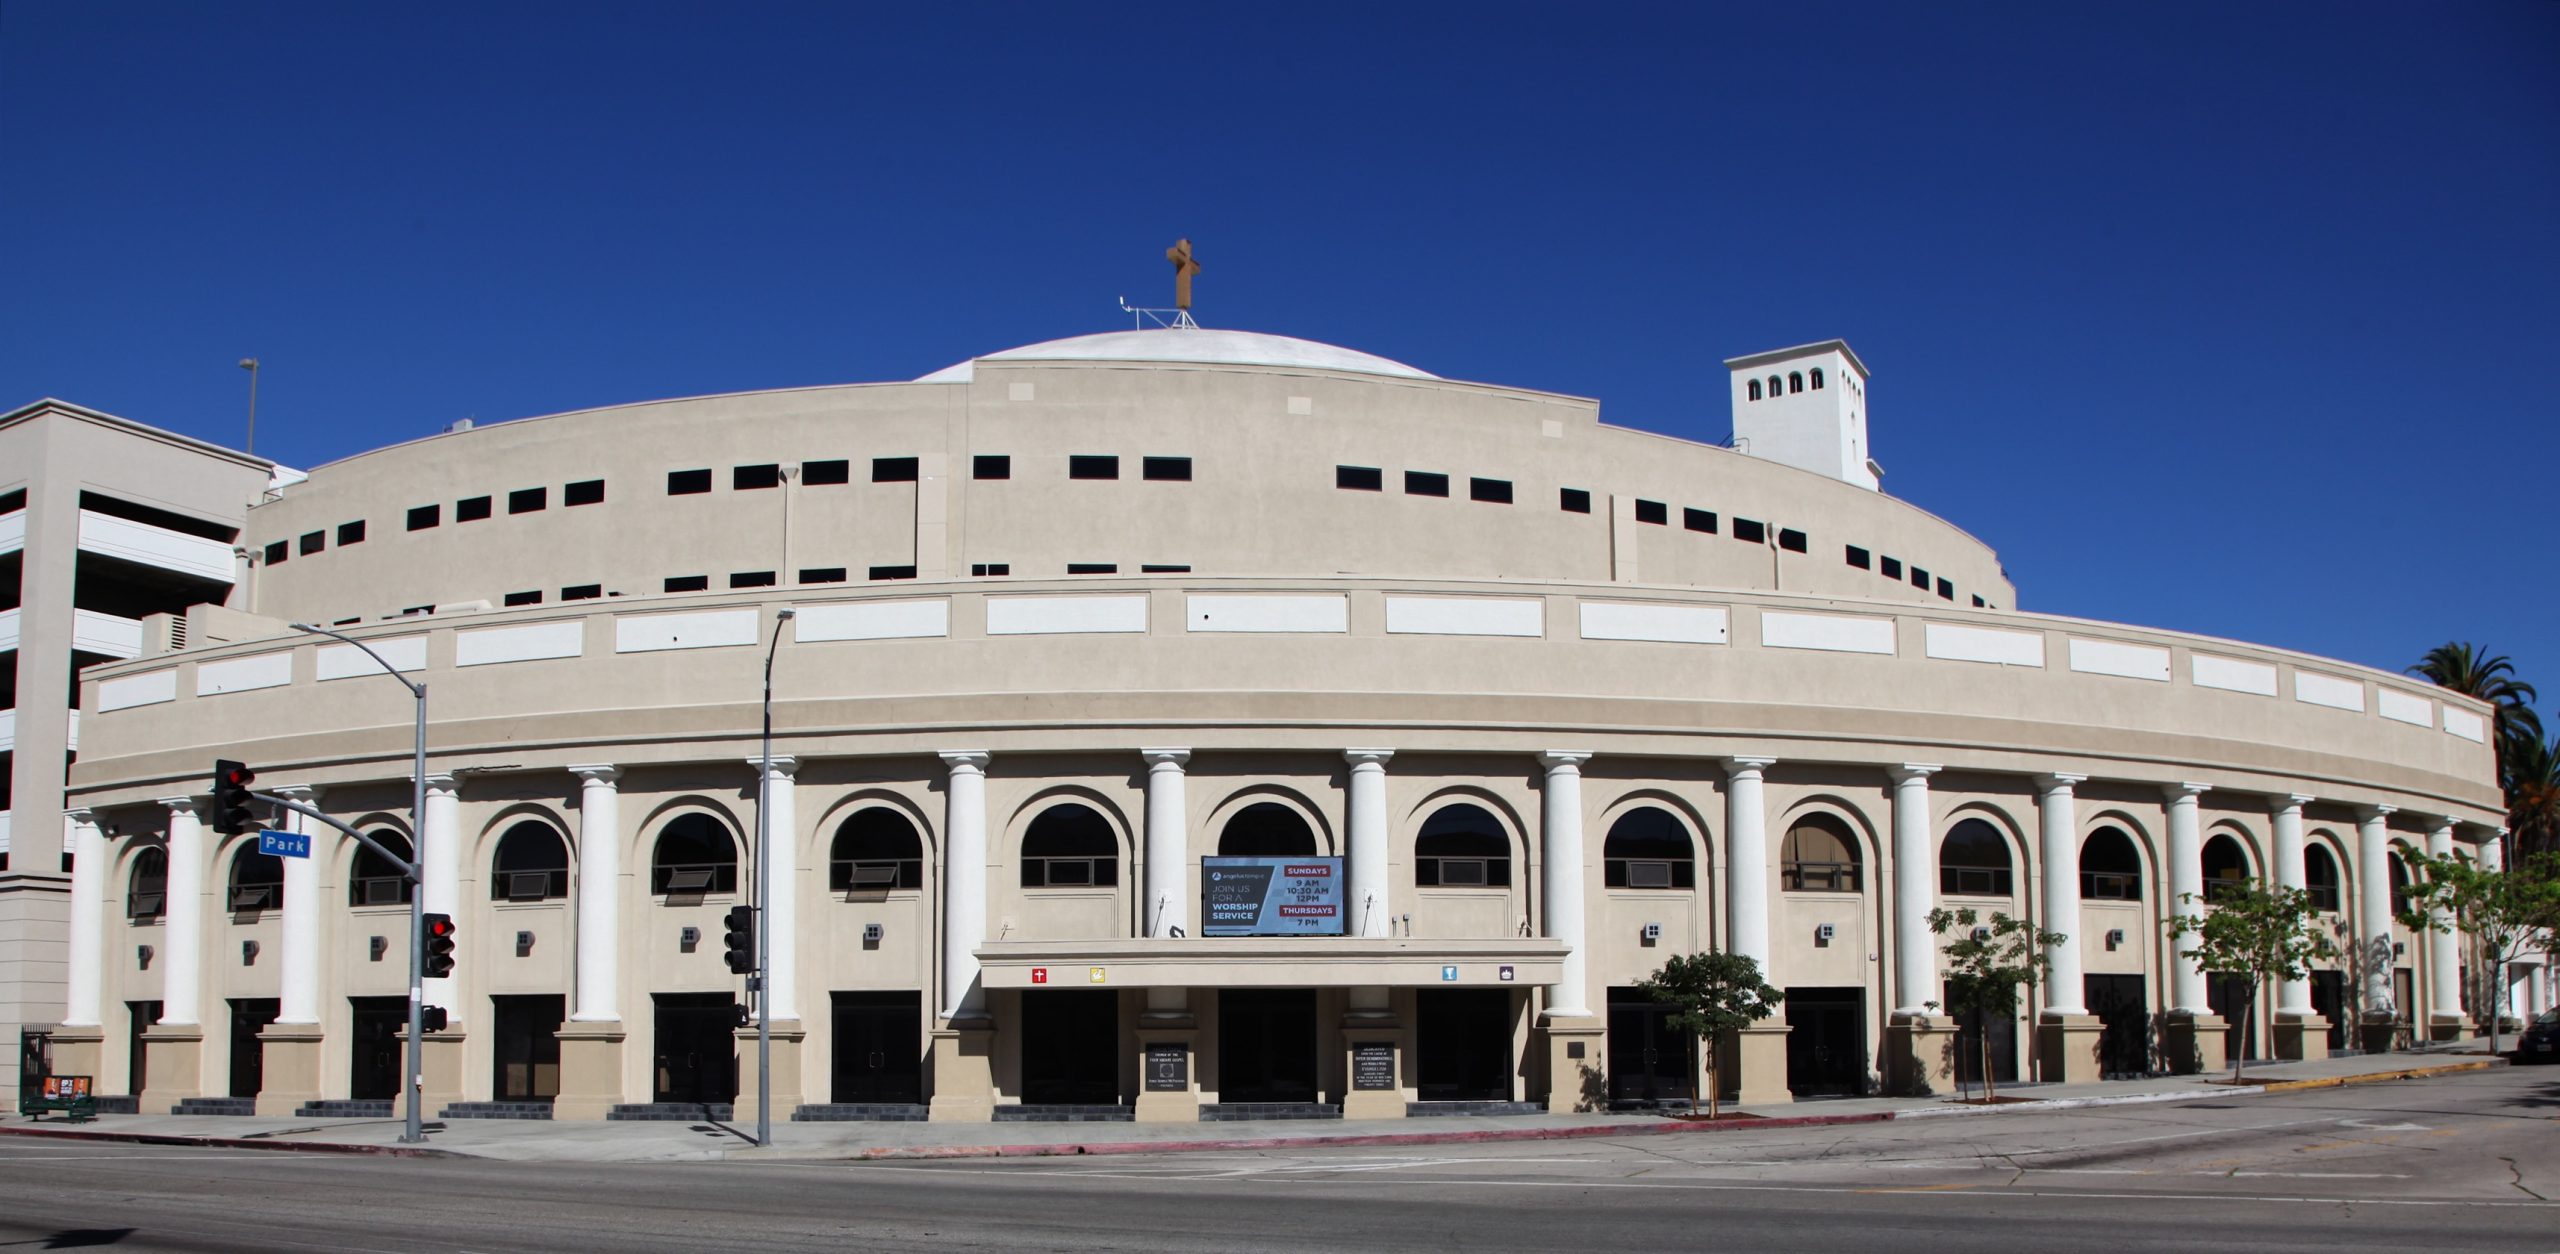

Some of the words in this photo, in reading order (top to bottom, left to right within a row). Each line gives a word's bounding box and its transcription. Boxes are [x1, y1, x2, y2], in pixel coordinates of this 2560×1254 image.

[266, 836, 304, 852] Park
[1213, 885, 1234, 893] JOIN
[1238, 885, 1250, 893] US
[1235, 894, 1243, 902] A
